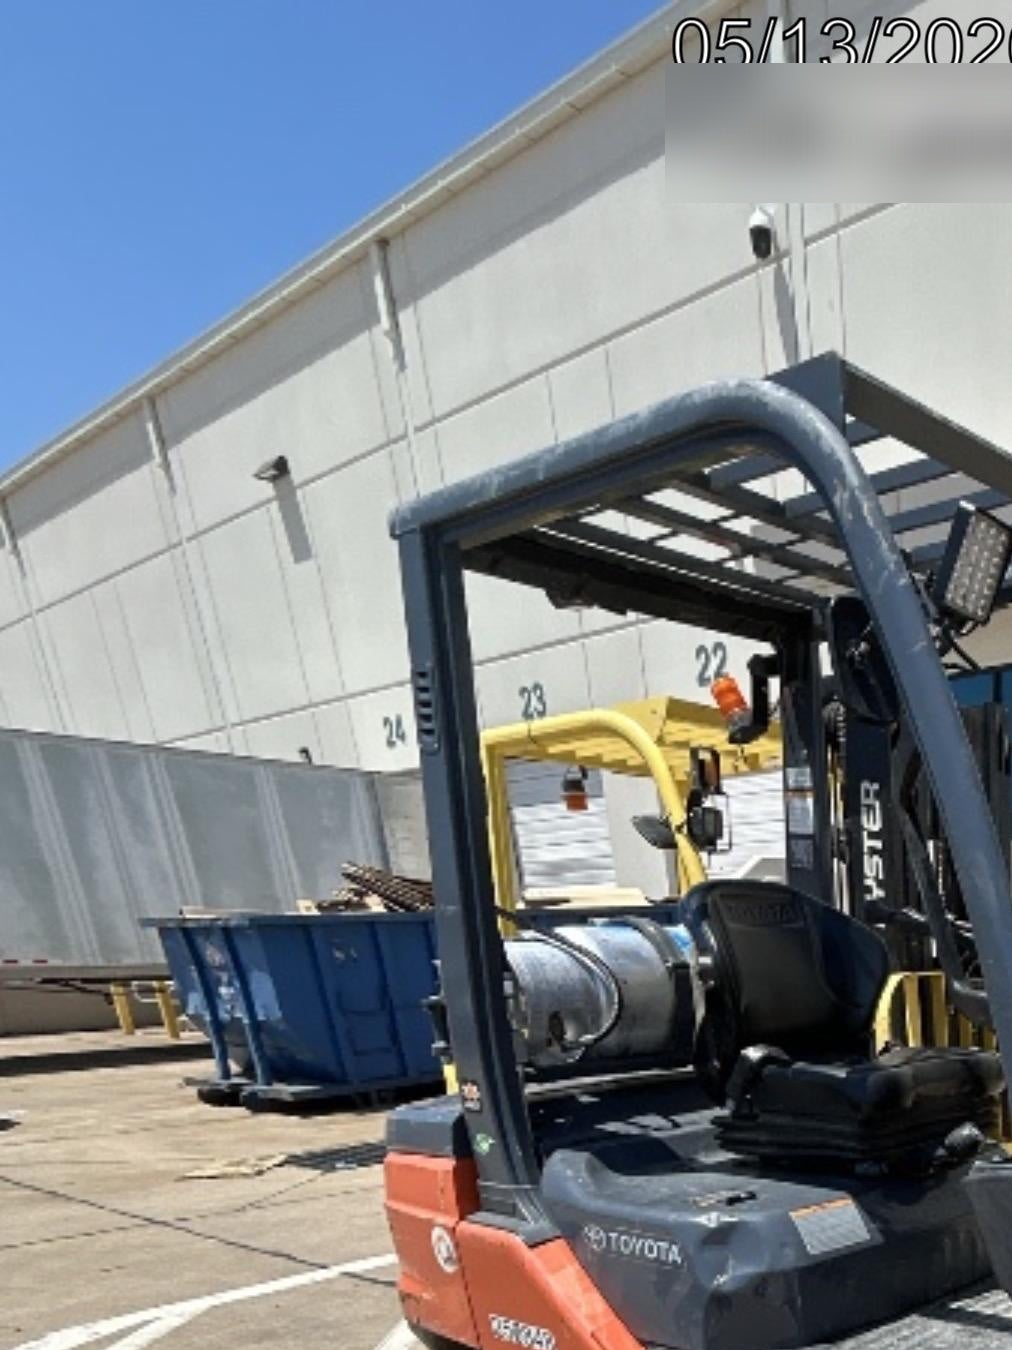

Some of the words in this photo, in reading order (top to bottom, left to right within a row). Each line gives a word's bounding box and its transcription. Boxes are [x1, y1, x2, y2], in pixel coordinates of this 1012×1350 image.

[694, 641, 729, 687] 22
[518, 681, 547, 720] 23
[382, 715, 406, 748] 24
[860, 779, 886, 901] YSTER
[607, 1231, 683, 1265] TOYOTA
